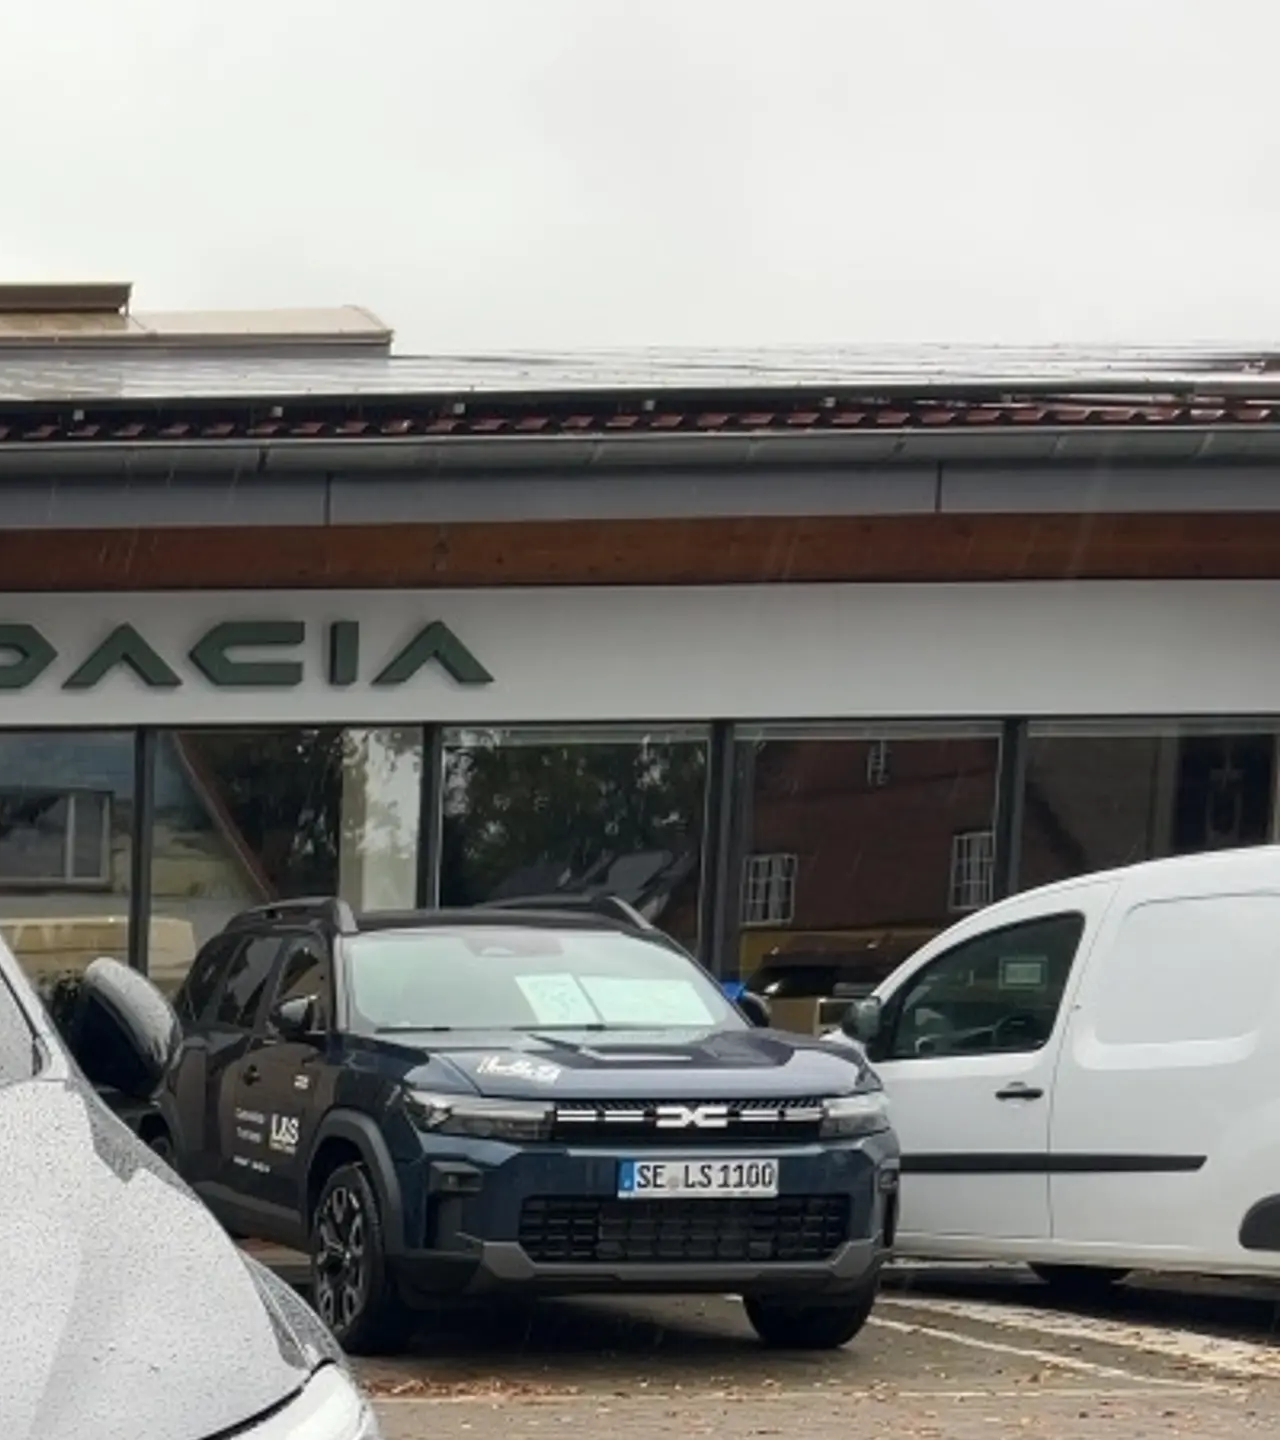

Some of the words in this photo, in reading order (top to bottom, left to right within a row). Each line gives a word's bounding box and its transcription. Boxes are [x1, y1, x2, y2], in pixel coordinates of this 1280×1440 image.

[636, 1164, 666, 1189] SE
[683, 1164, 713, 1189] LS
[717, 1162, 775, 1189] 1100
